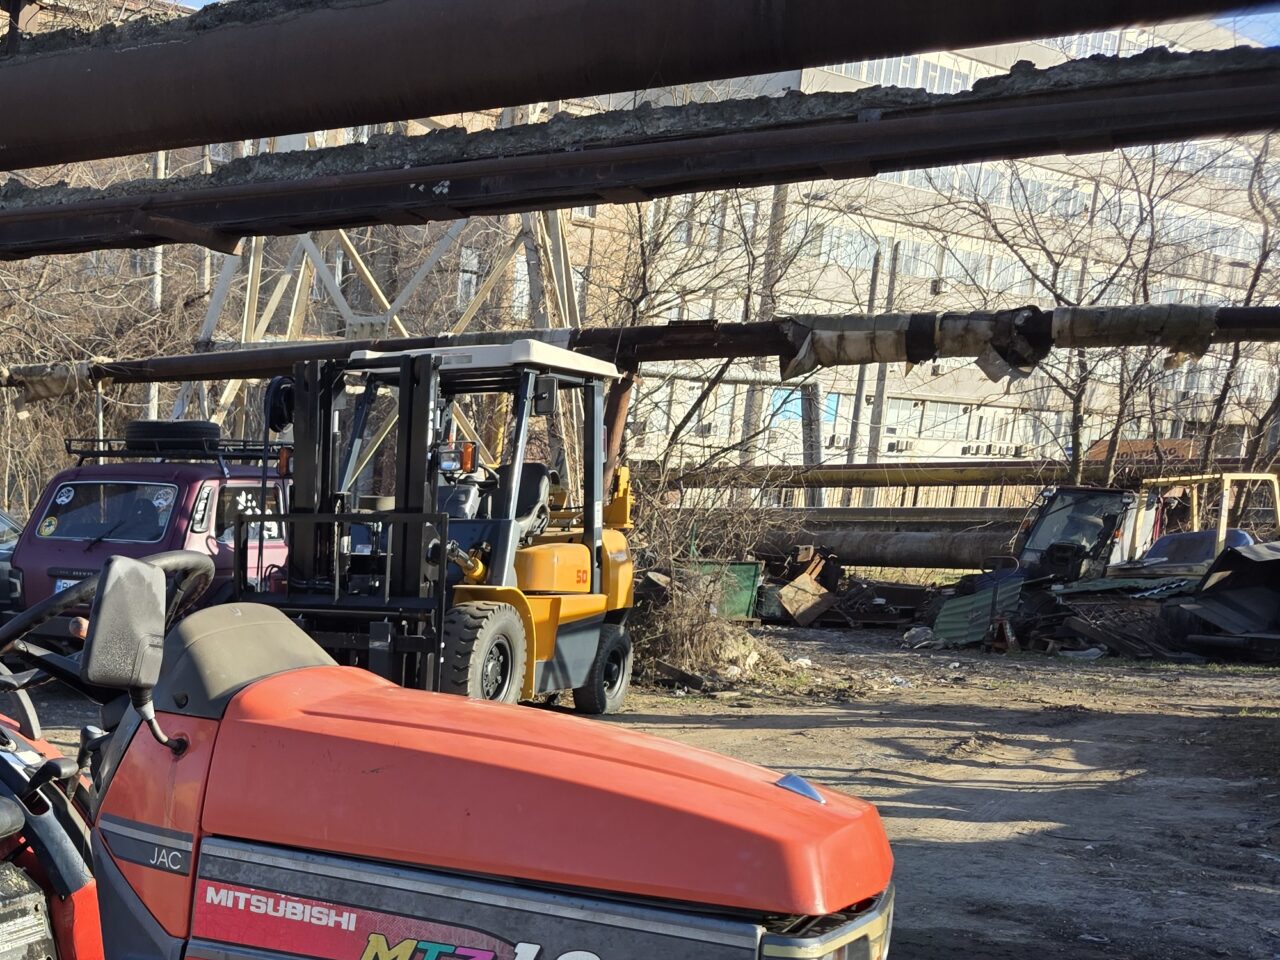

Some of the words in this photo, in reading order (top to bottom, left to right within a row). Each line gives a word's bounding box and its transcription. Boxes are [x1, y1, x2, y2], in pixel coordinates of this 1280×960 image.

[576, 569, 588, 584] 50
[149, 847, 182, 870] JAC
[205, 886, 357, 932] MITSUBISHI
